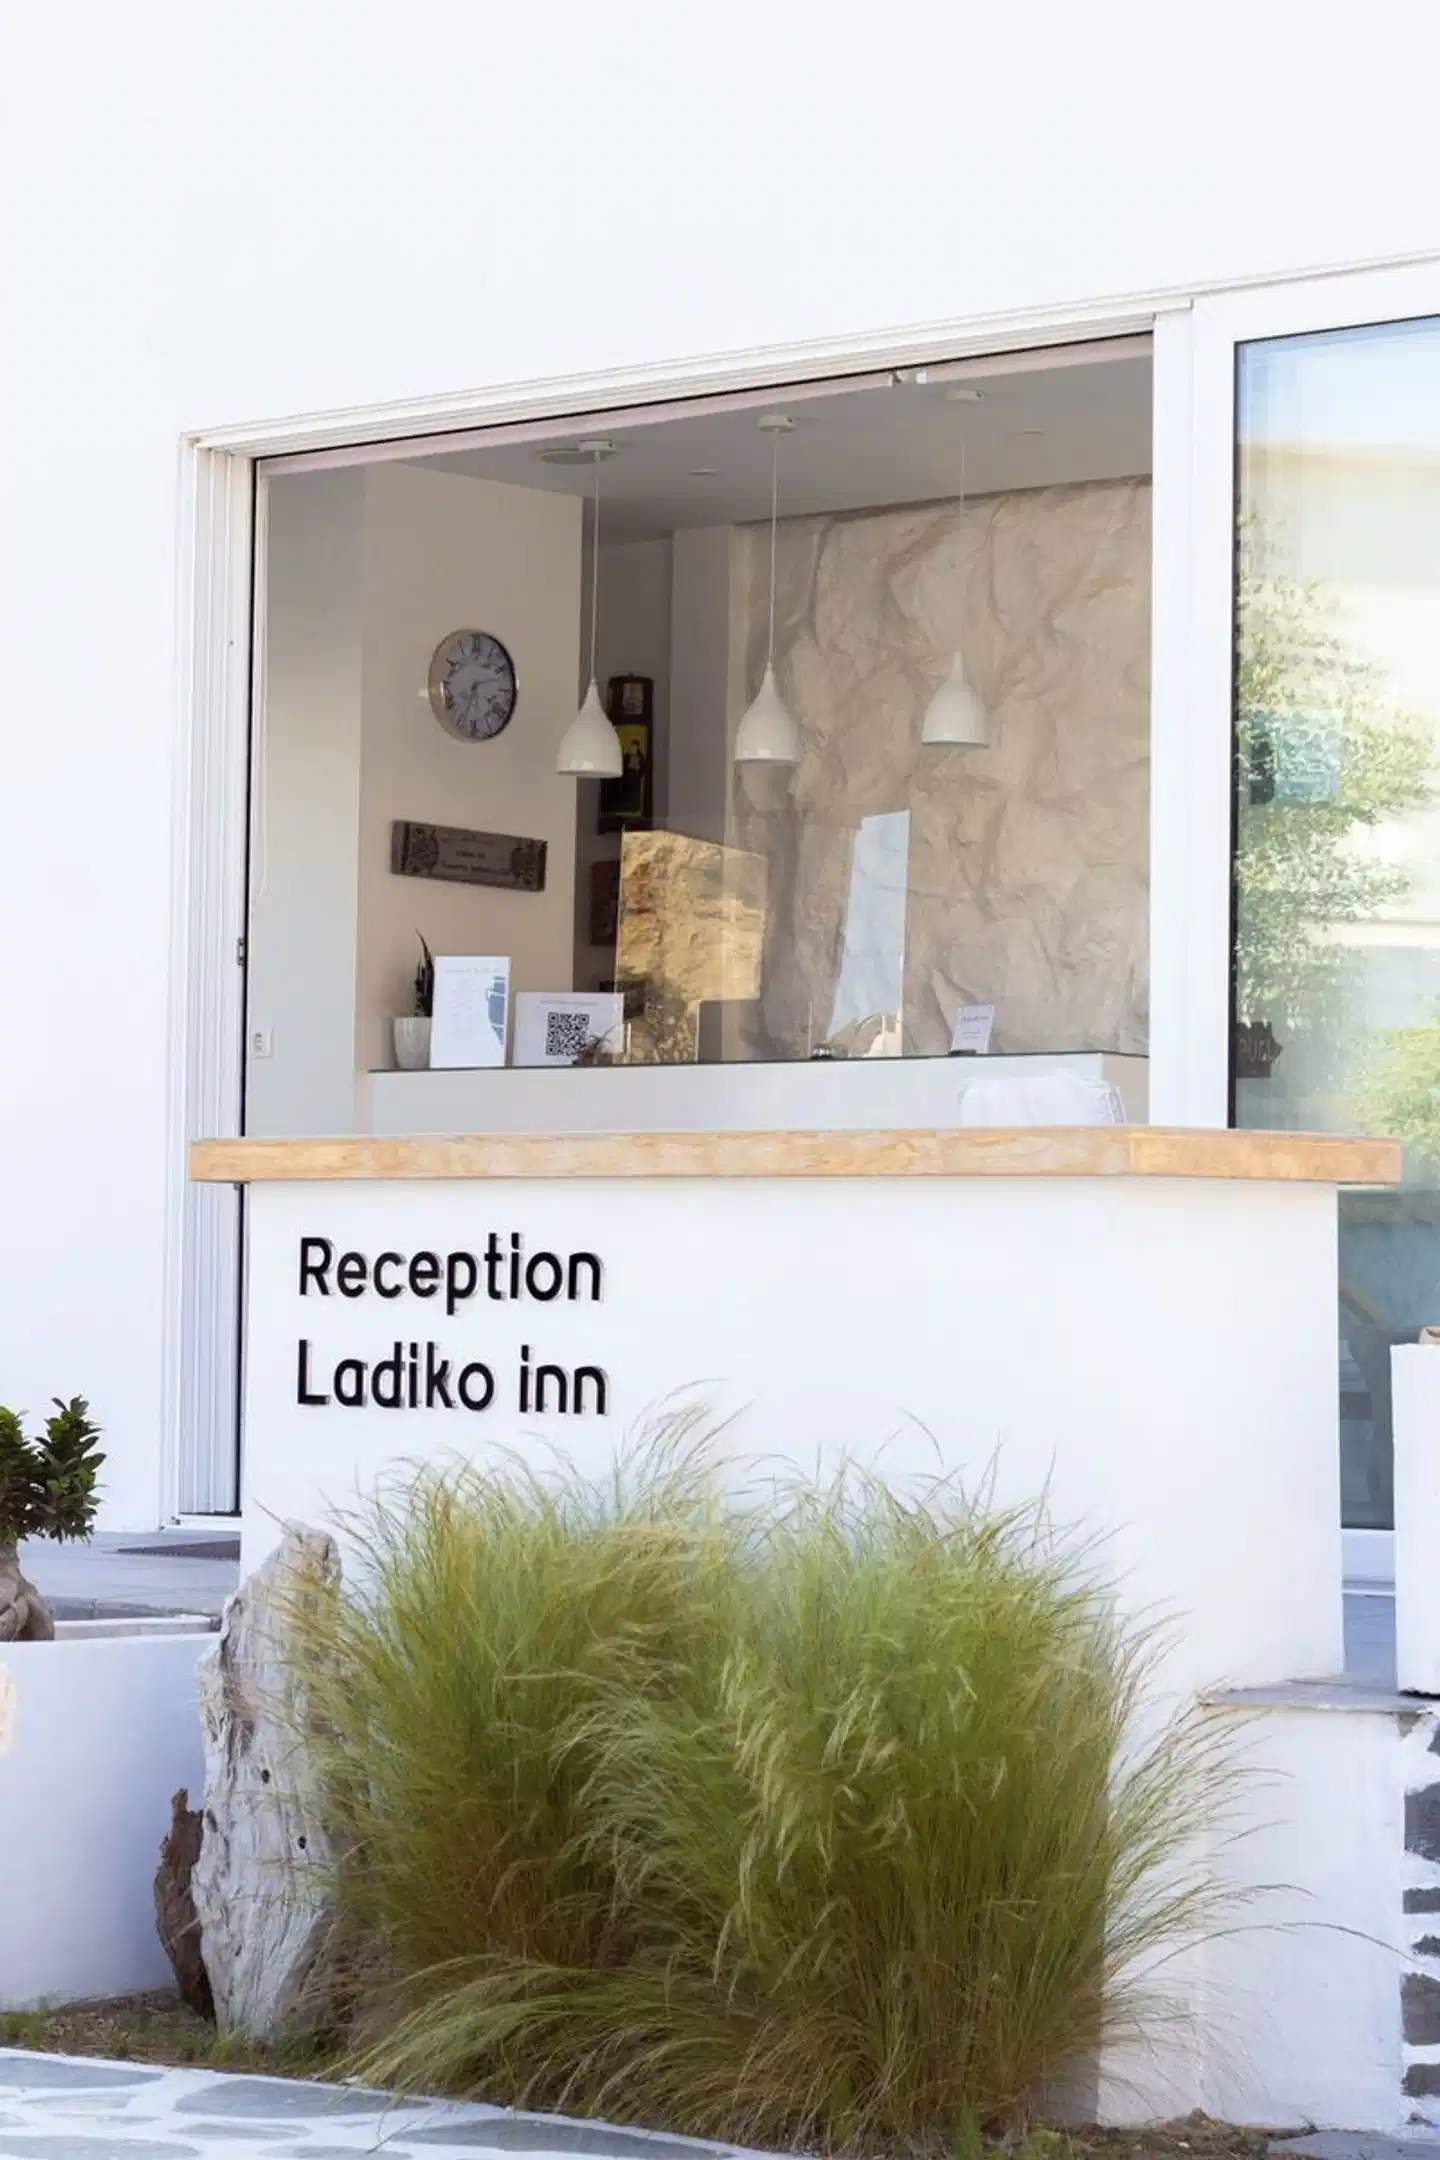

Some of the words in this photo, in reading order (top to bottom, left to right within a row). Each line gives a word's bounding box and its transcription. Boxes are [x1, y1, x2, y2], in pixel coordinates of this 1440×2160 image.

[299, 1232, 604, 1316] Reception
[297, 1339, 495, 1412] Ladiko
[519, 1345, 608, 1415] inn
